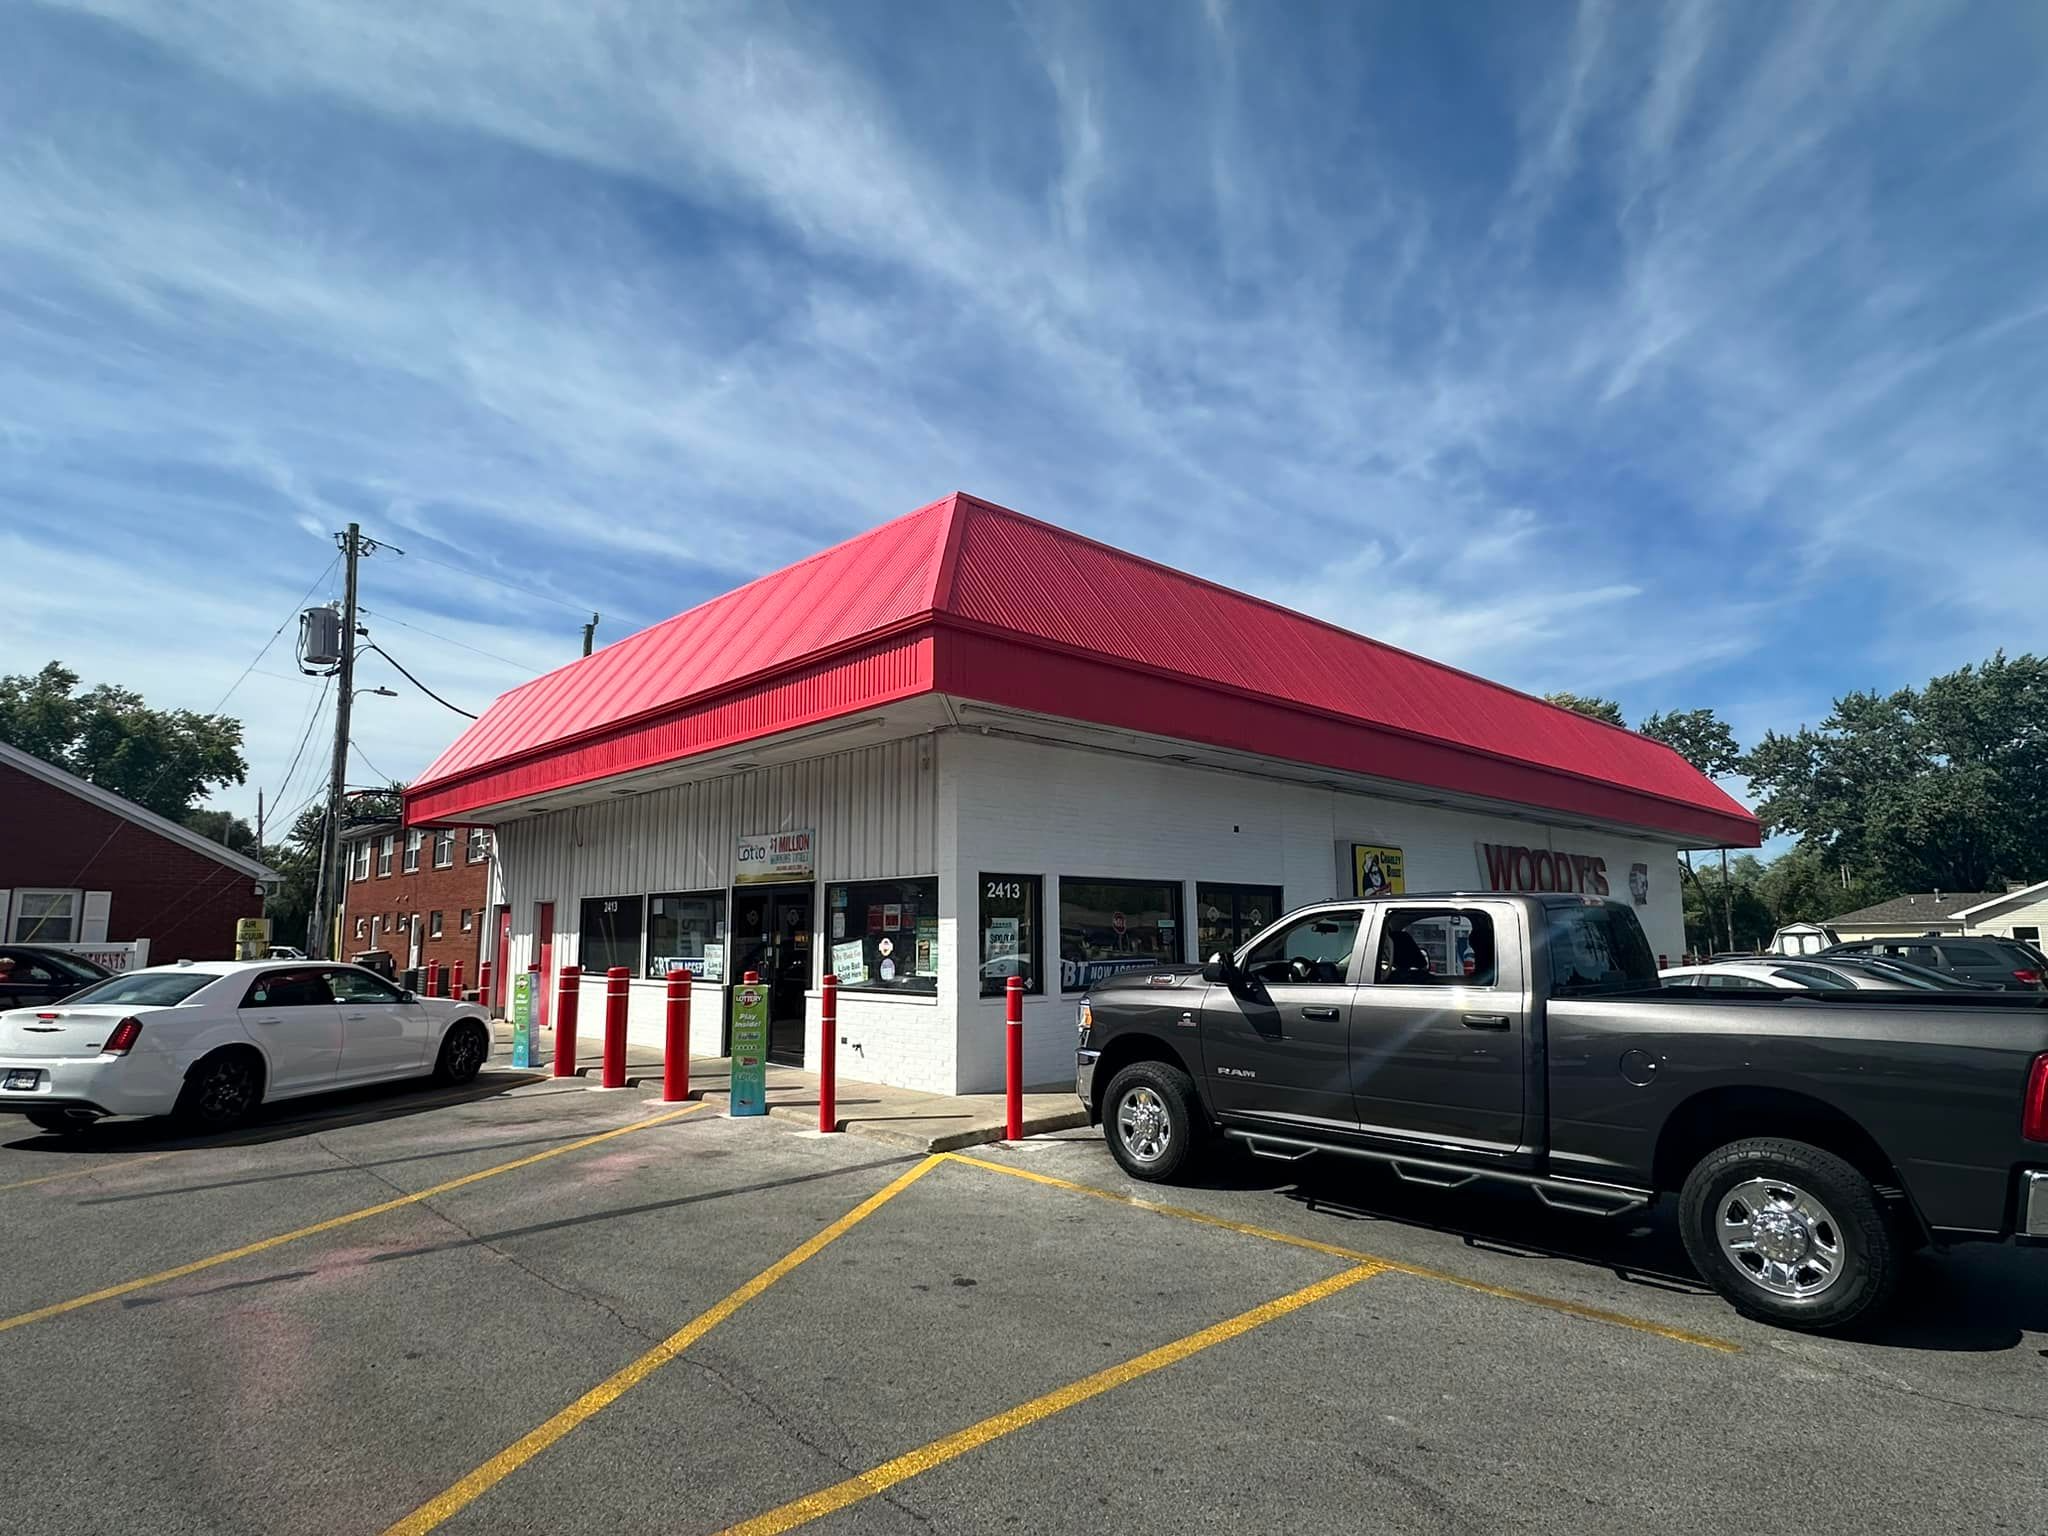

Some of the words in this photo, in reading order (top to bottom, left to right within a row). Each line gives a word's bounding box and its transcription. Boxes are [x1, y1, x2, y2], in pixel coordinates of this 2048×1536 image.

[779, 834, 809, 853] MILLION
[1484, 844, 1609, 896] WOODY'S
[987, 882, 1020, 898] 2413
[604, 901, 618, 913] 2413
[243, 920, 257, 928] AIR
[1090, 965, 1112, 980] NOW
[739, 1013, 757, 1021] Play
[1217, 1067, 1256, 1078] RAM
